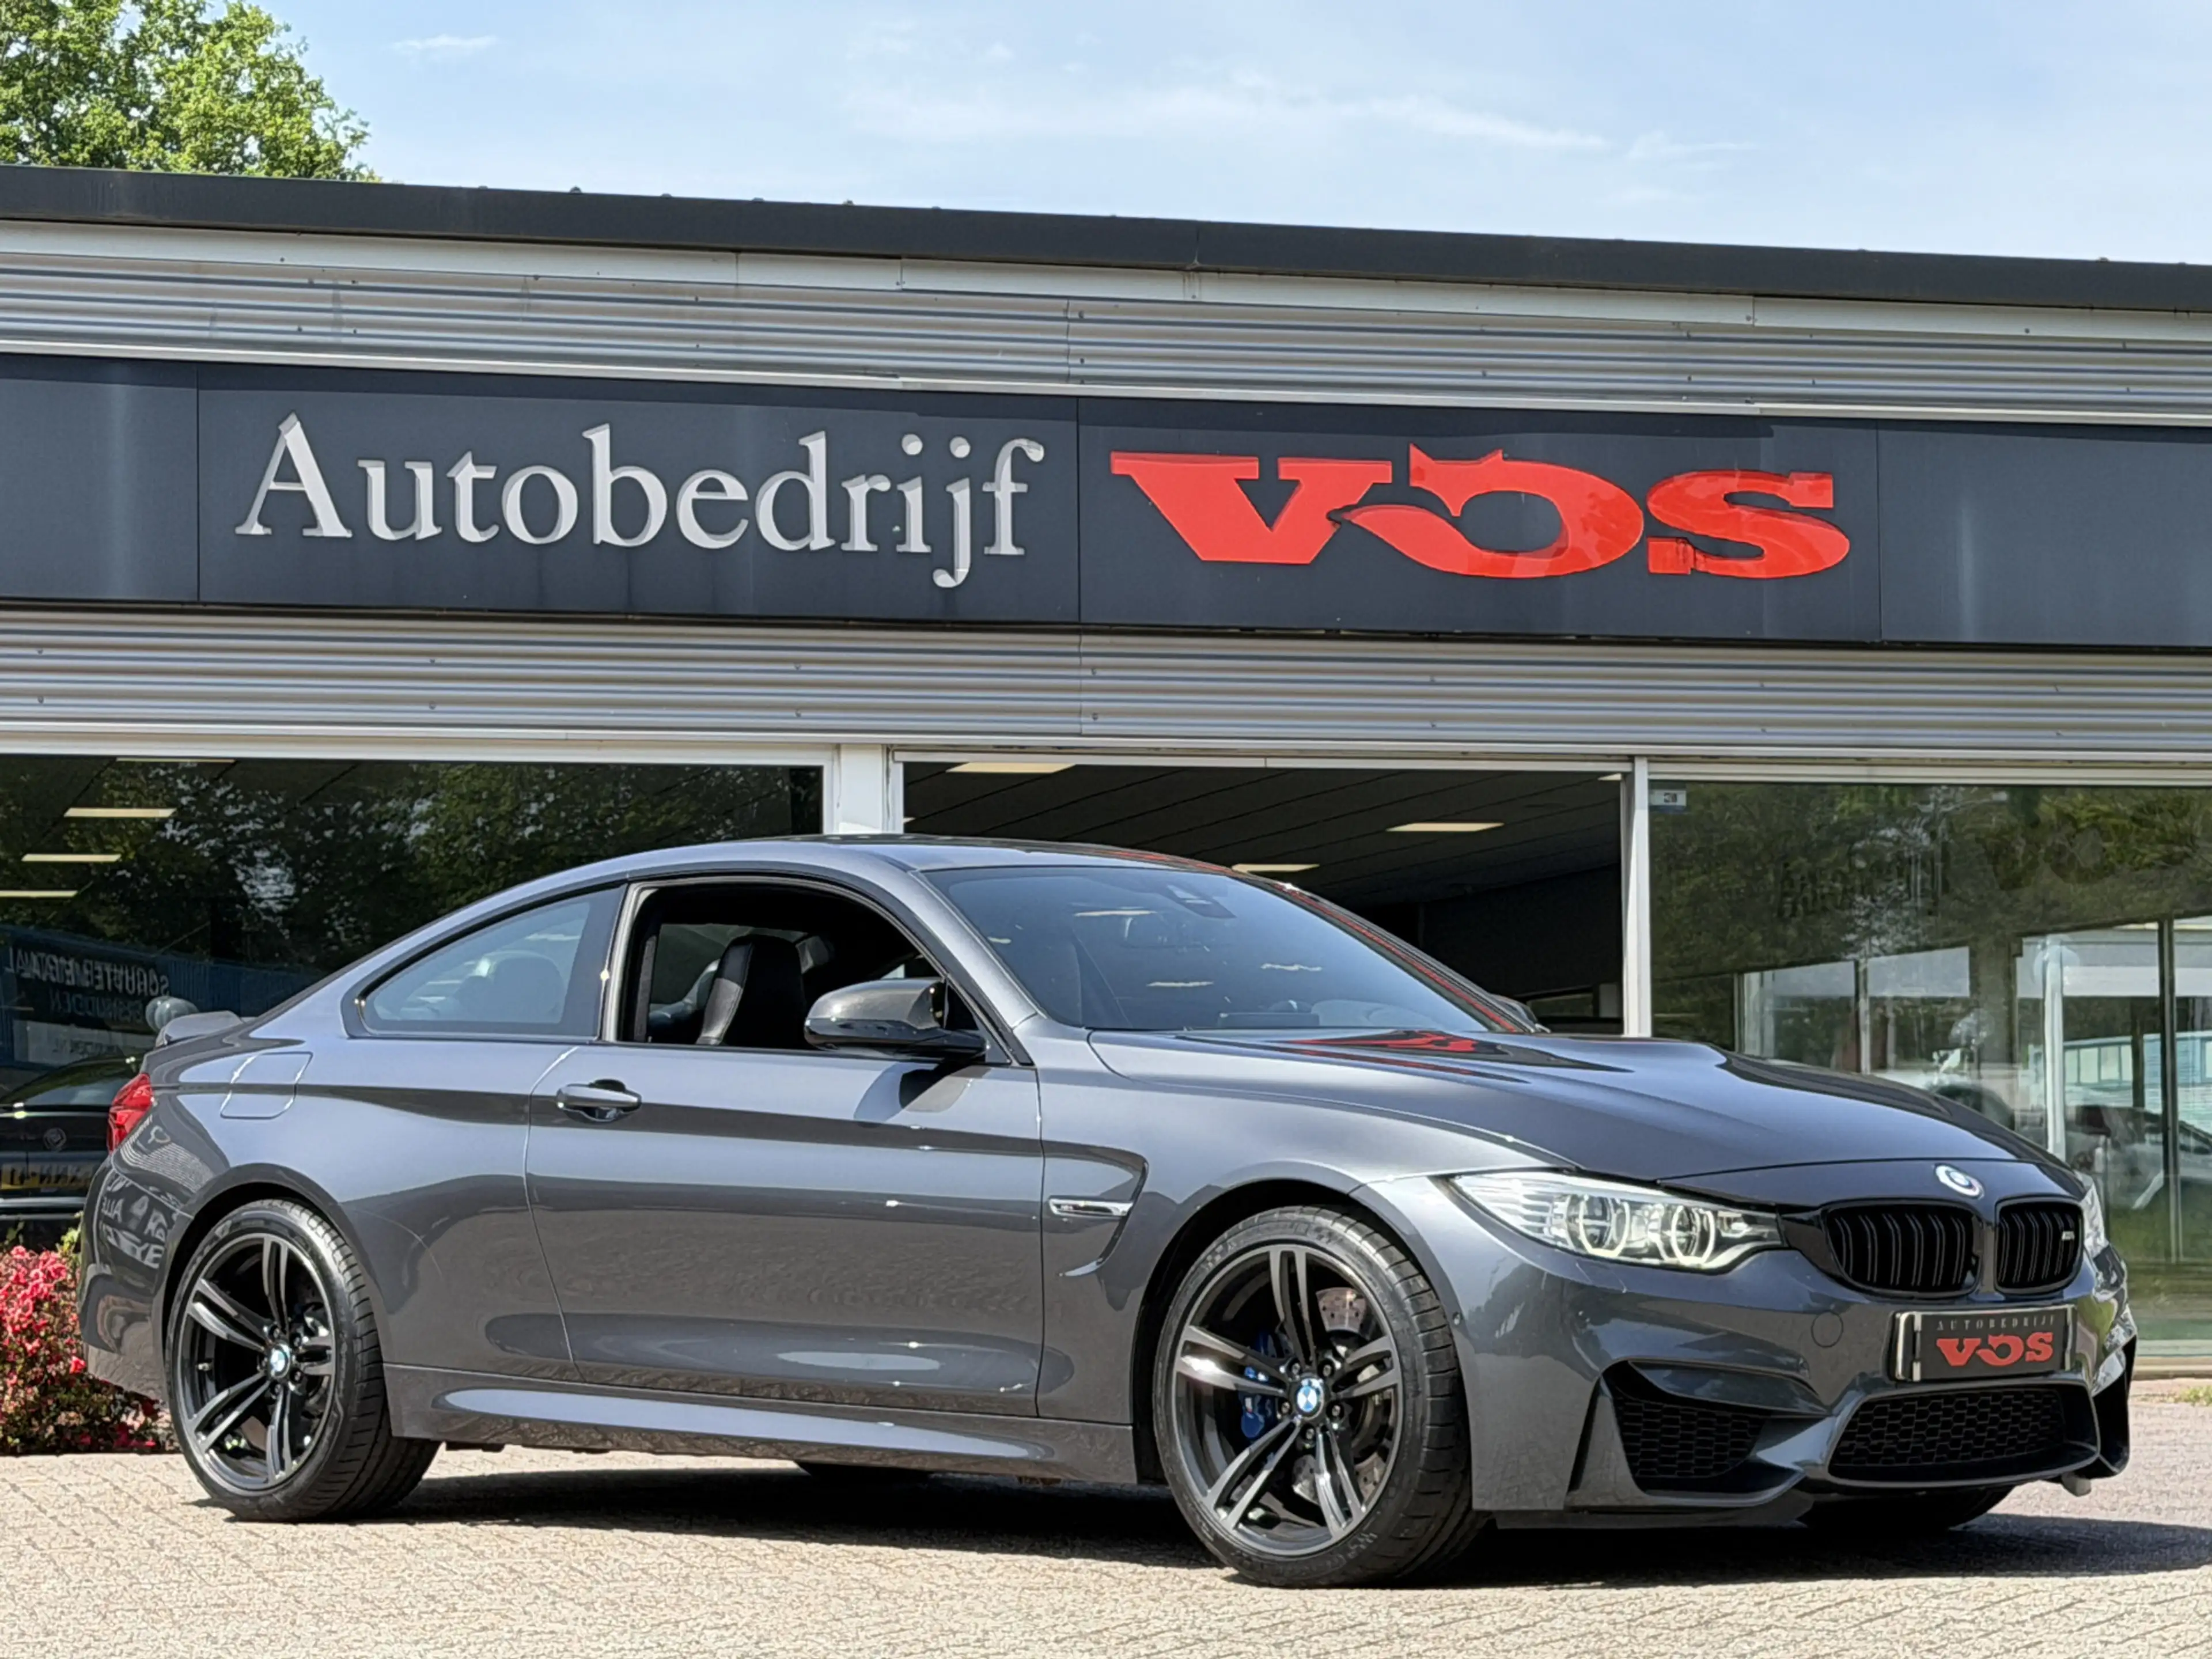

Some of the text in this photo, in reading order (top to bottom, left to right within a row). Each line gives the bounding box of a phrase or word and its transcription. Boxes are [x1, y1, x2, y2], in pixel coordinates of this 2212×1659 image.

[235, 412, 1850, 589] Autobedrijf VOS
[1936, 1332, 2054, 1367] VOS
